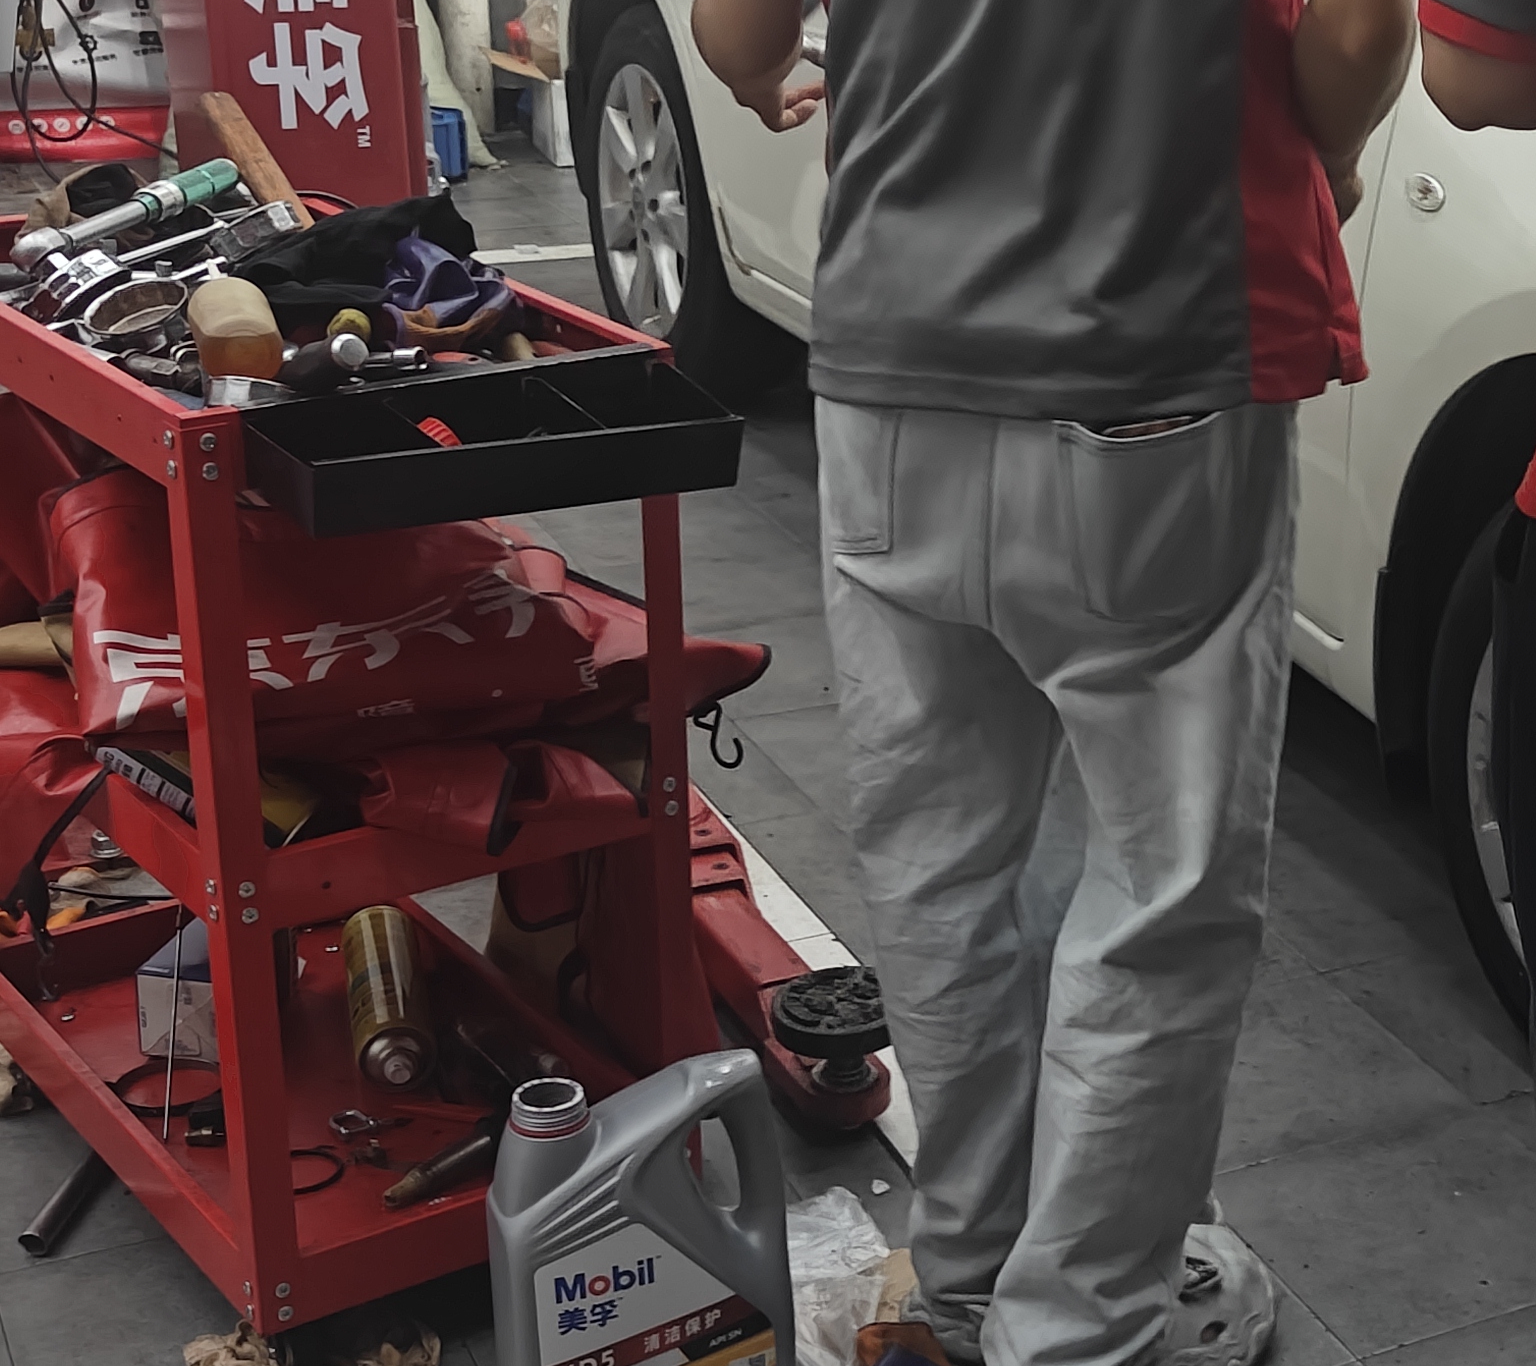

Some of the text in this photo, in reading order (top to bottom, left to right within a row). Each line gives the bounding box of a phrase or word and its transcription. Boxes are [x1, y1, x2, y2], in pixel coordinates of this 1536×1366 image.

[554, 1257, 655, 1304] Mobil
[558, 1299, 619, 1336] 美孚
[644, 1308, 722, 1354] 清洁保护
